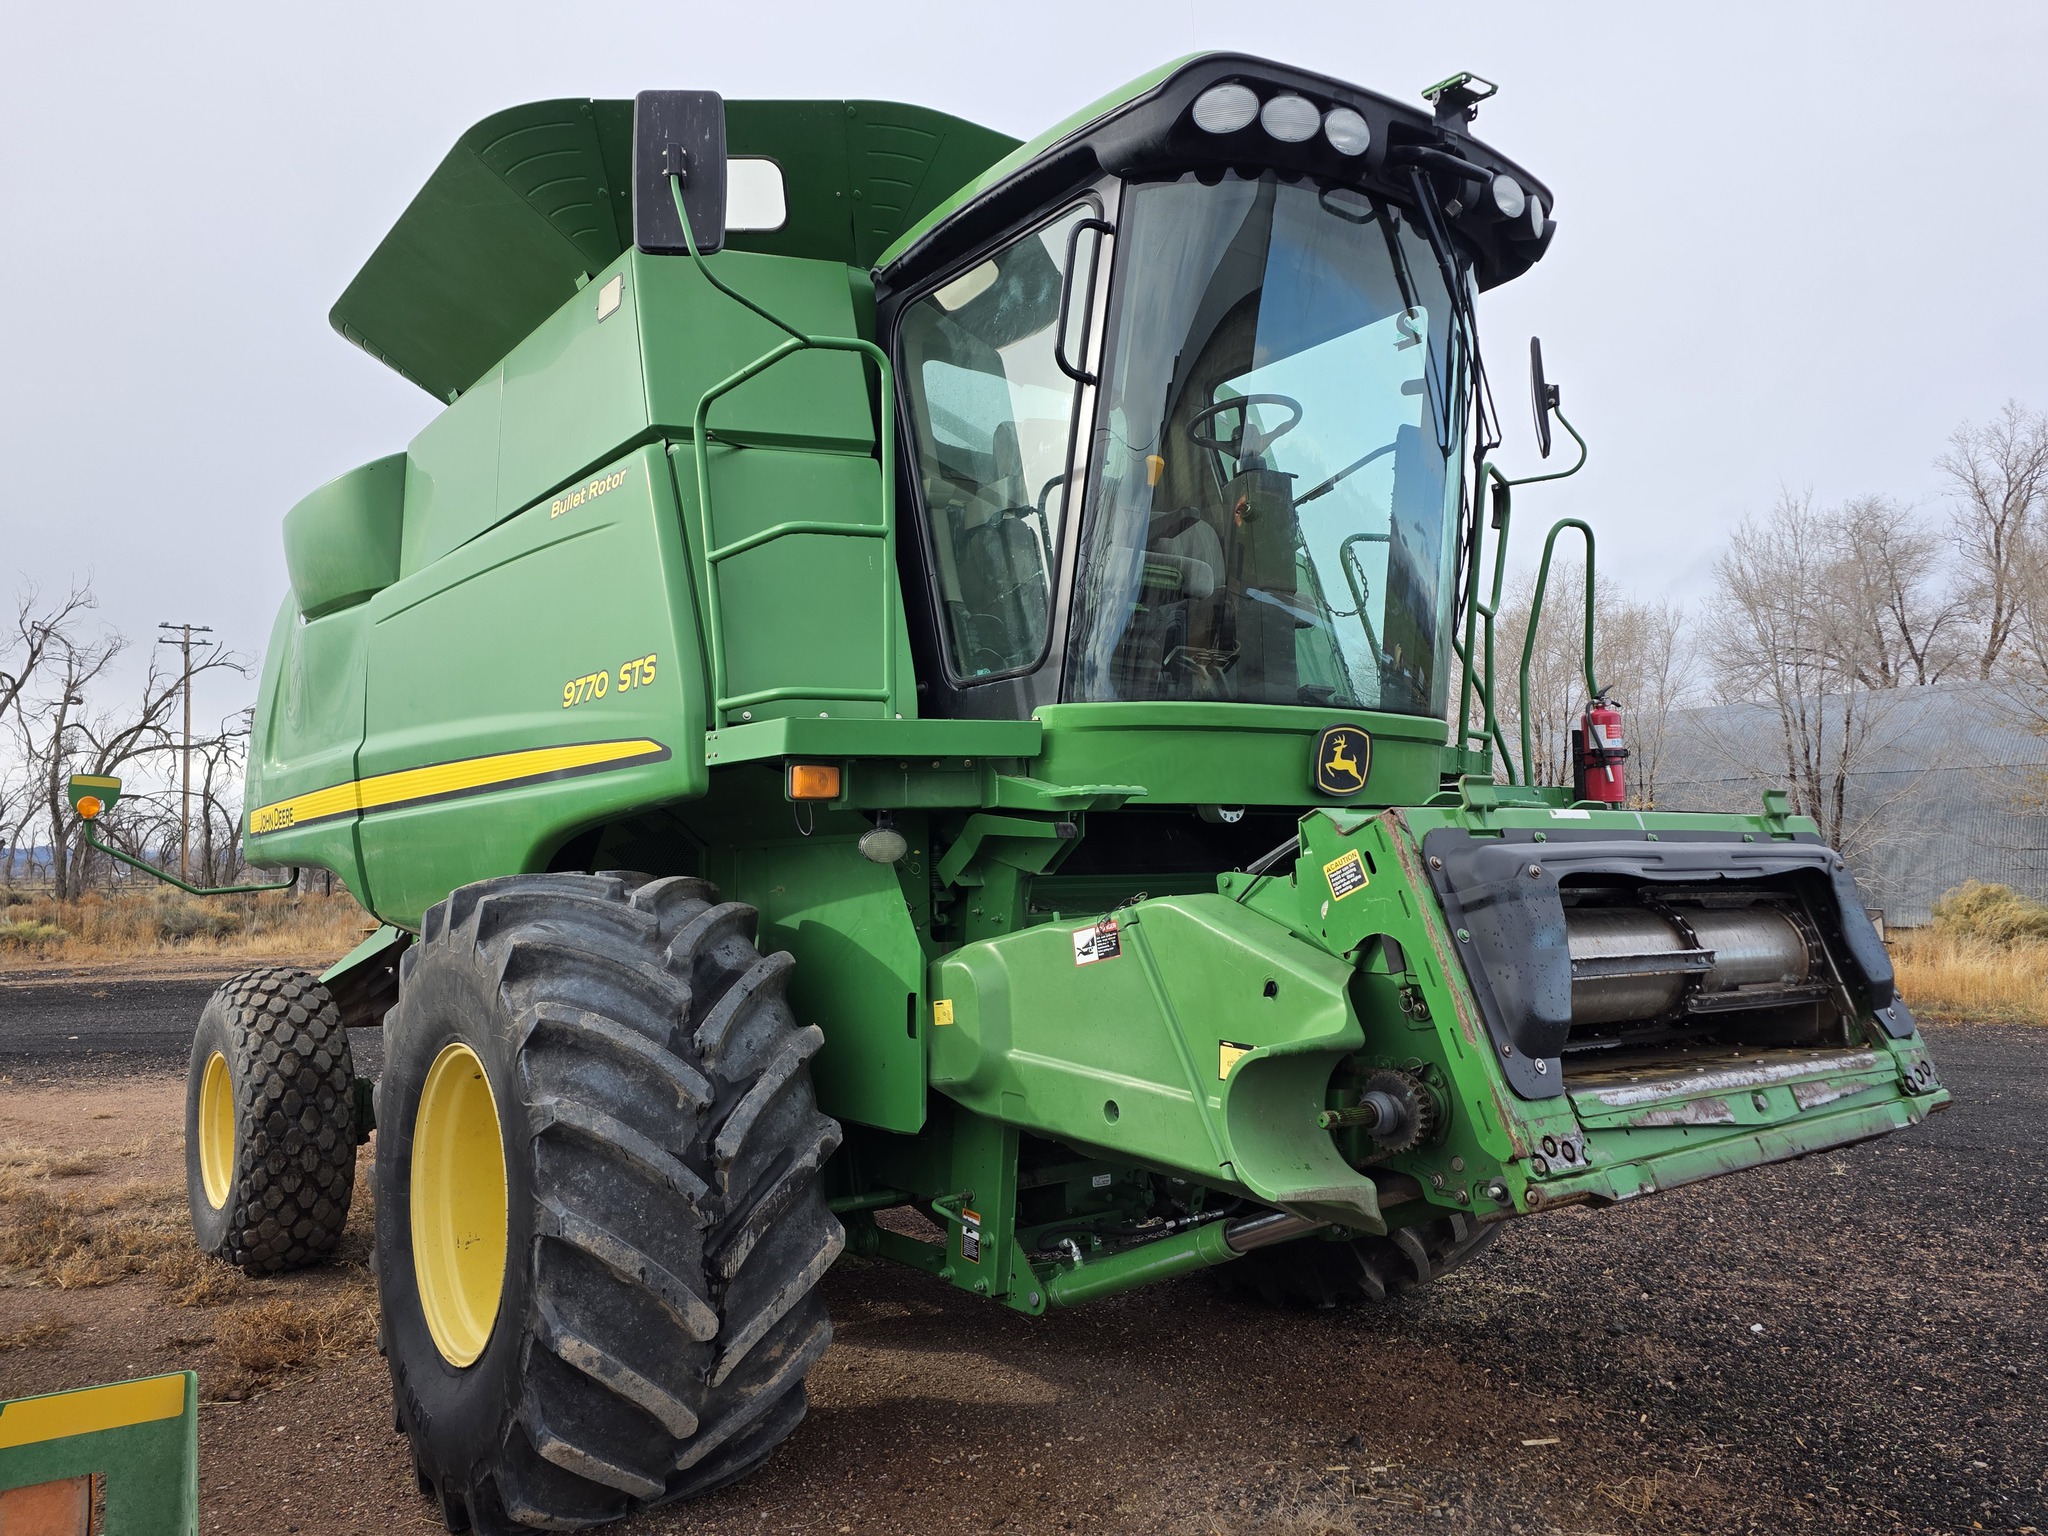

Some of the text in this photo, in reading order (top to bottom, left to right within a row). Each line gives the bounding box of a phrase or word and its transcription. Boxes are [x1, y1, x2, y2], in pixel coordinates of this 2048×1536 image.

[550, 468, 627, 520] Bullet Rotor
[562, 652, 657, 709] 9770 STS
[274, 807, 294, 828] DEERE
[1330, 851, 1358, 871] CAUTION
